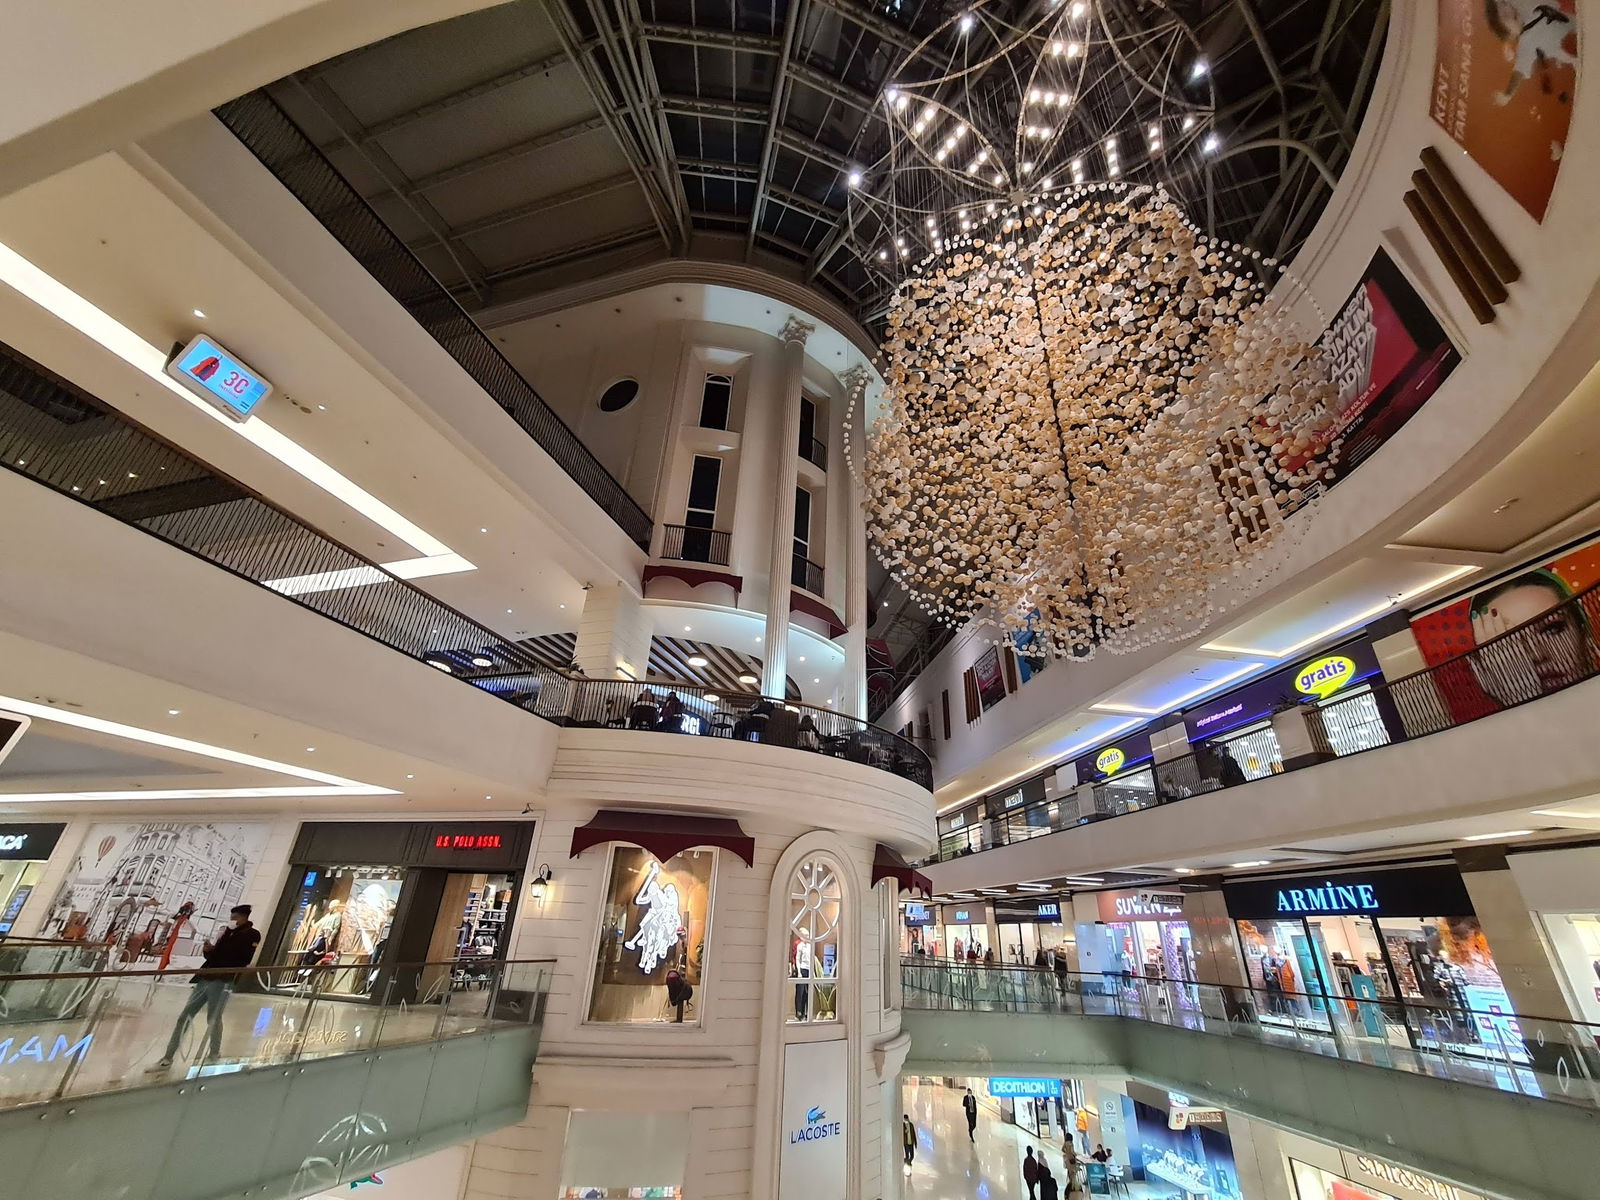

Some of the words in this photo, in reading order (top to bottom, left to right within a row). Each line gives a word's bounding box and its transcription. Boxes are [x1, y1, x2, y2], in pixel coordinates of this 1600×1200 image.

[1459, 43, 1472, 99] SANA
[1435, 63, 1449, 124] KENT
[1300, 660, 1346, 691] gratis
[1099, 750, 1120, 769] gratis
[436, 835, 450, 848] U.S.
[453, 835, 475, 848] POLO
[1277, 881, 1379, 911] ARMİNE
[1038, 904, 1058, 915] AKER
[992, 1081, 1046, 1094] DECATHLON
[790, 1121, 841, 1145] LACOSTE
